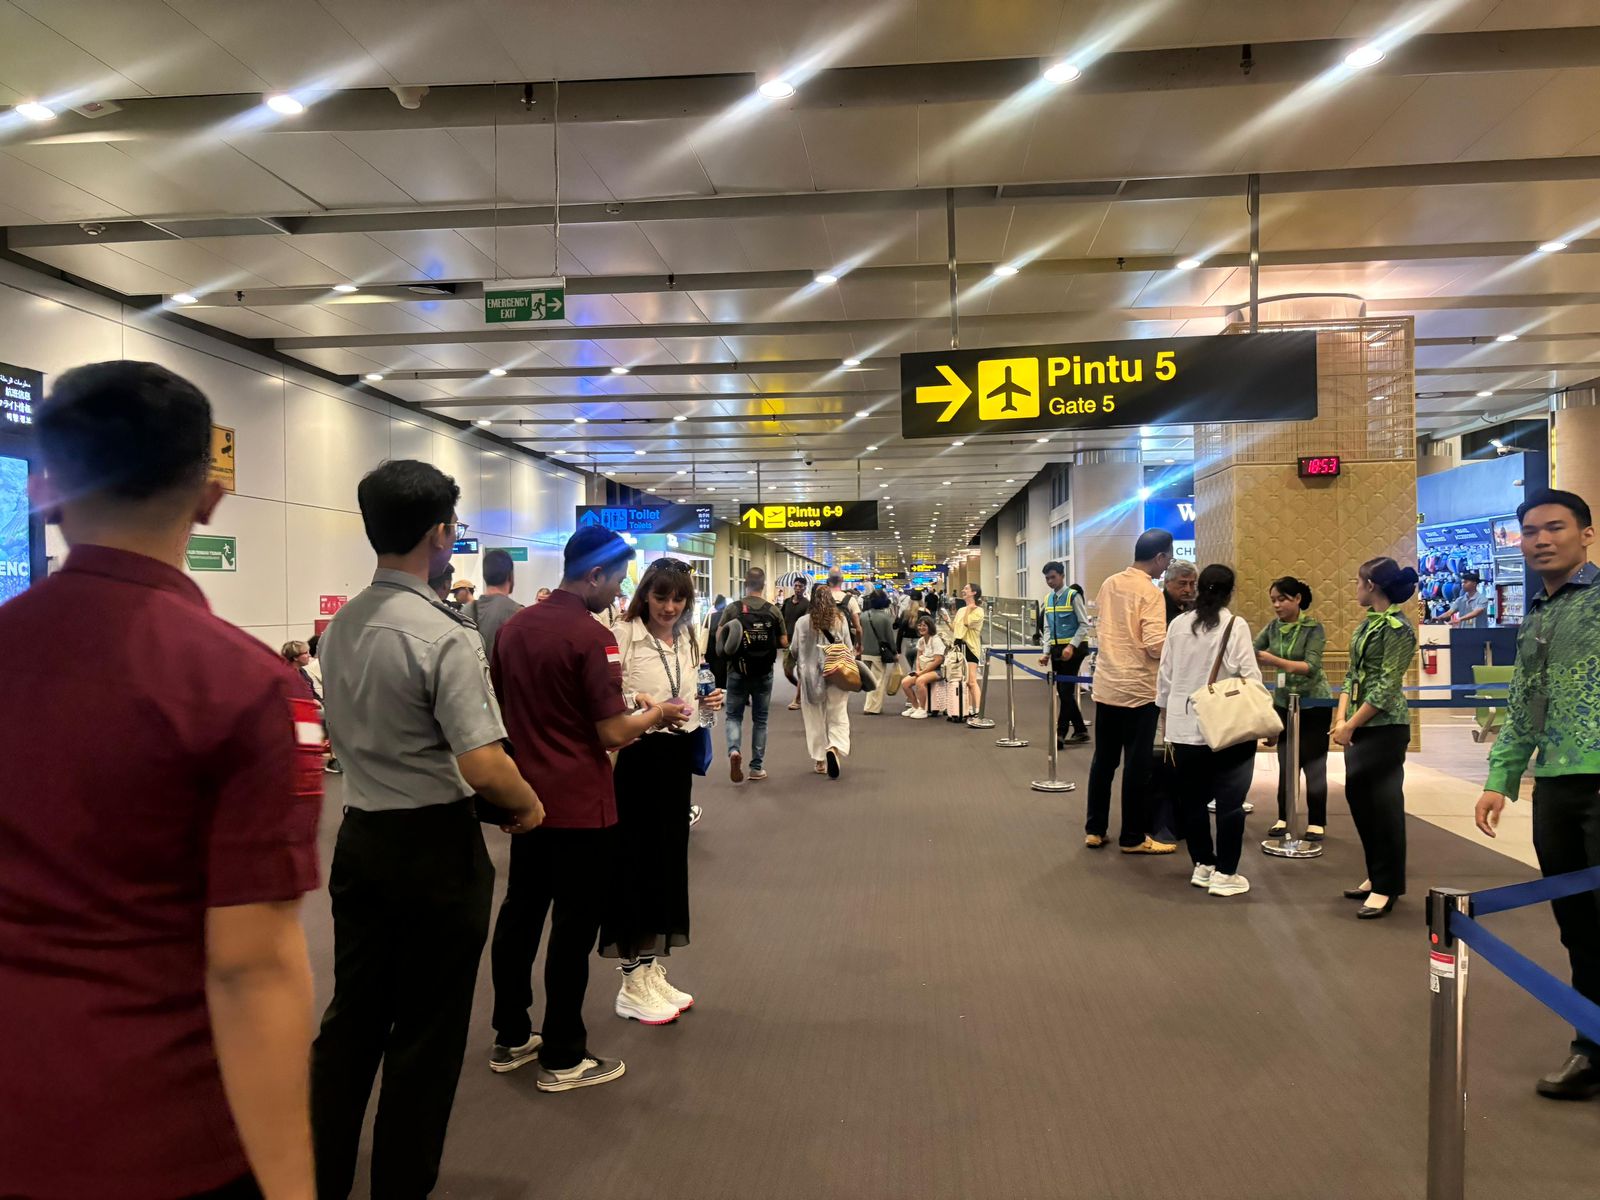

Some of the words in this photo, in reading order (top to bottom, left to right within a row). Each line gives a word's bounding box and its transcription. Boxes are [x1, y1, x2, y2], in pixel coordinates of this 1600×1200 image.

[487, 297, 529, 309] EMERGENCY
[500, 308, 516, 319] EXIT
[1047, 355, 1142, 387] Pintu
[1155, 351, 1177, 381] 5
[1048, 397, 1097, 415] Gate
[1102, 395, 1115, 413] 5
[1308, 458, 1337, 474] 18:53
[629, 509, 660, 520] Toilet
[787, 506, 820, 518] Pintu
[822, 505, 843, 517] 6-9
[629, 521, 652, 529] Toilets
[787, 520, 809, 528] Gates
[809, 519, 821, 527] 6-9
